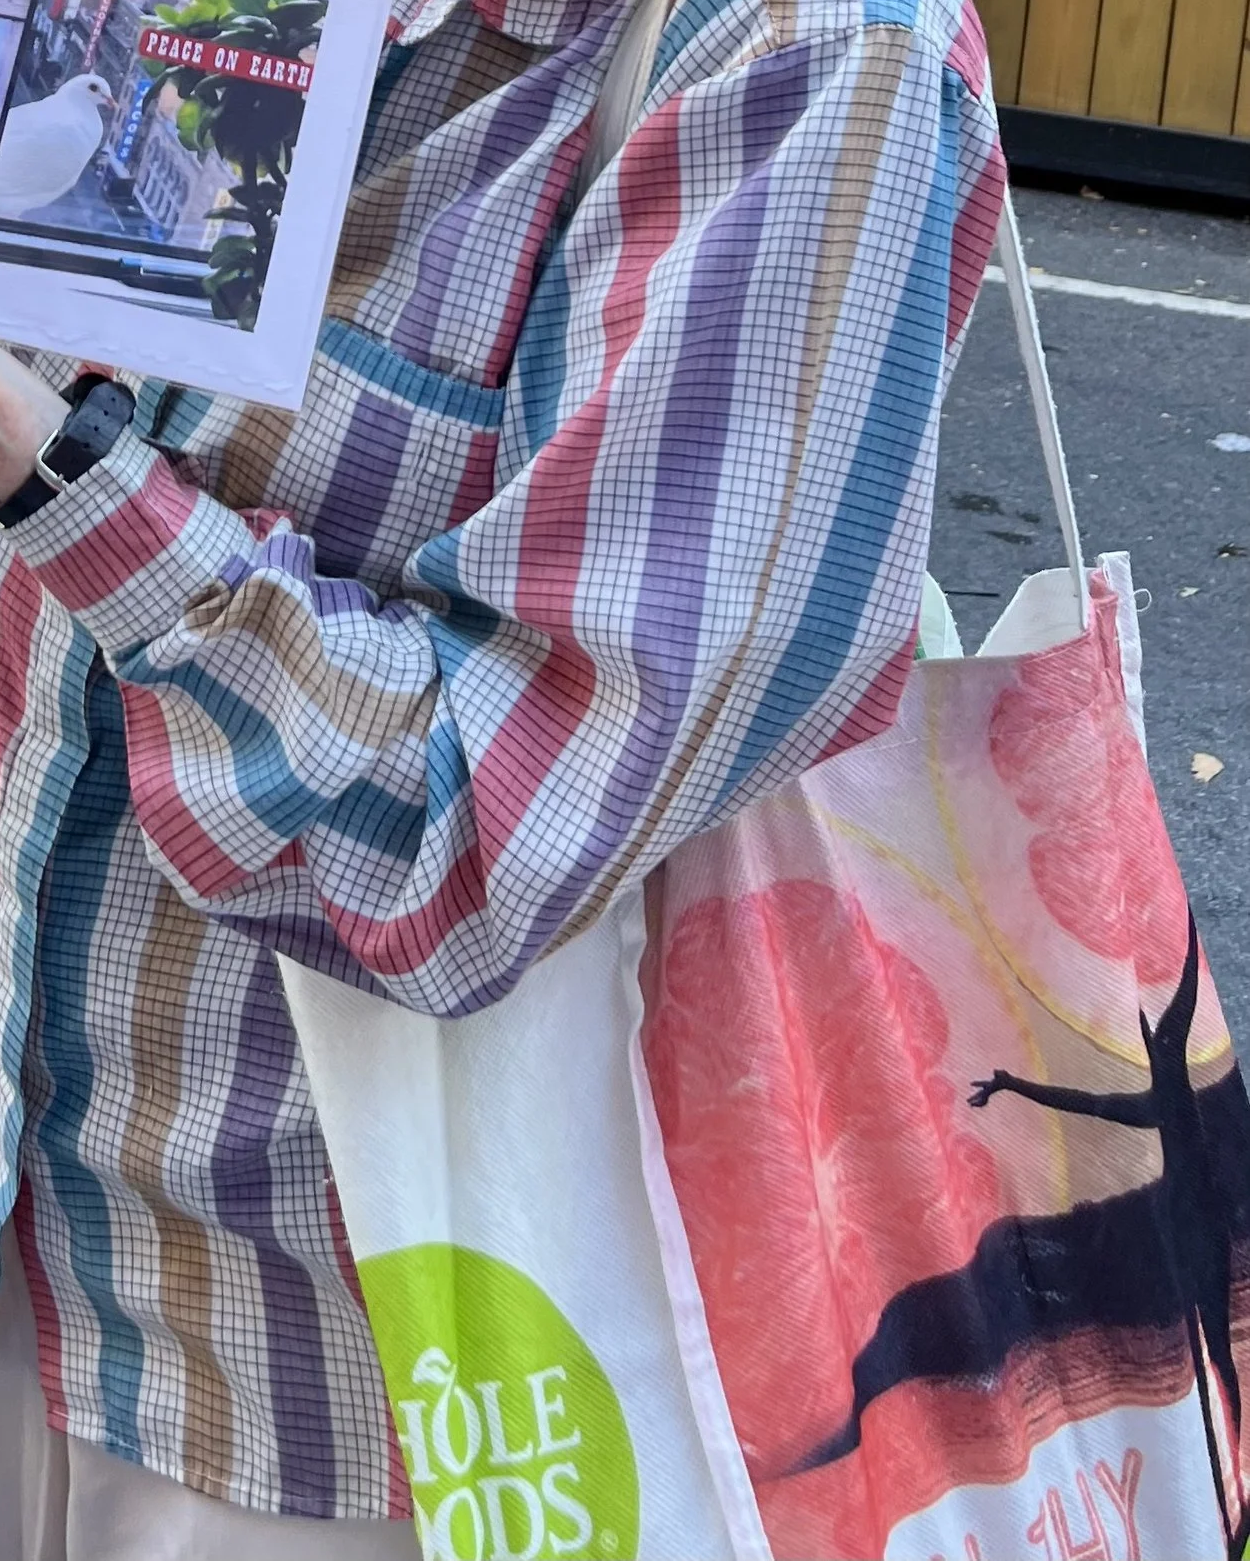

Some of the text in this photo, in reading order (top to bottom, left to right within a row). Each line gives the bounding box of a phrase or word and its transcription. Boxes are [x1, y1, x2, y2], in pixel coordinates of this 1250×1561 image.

[146, 32, 311, 88] PEACE ON EARTH
[413, 1461, 594, 1561] ODS
